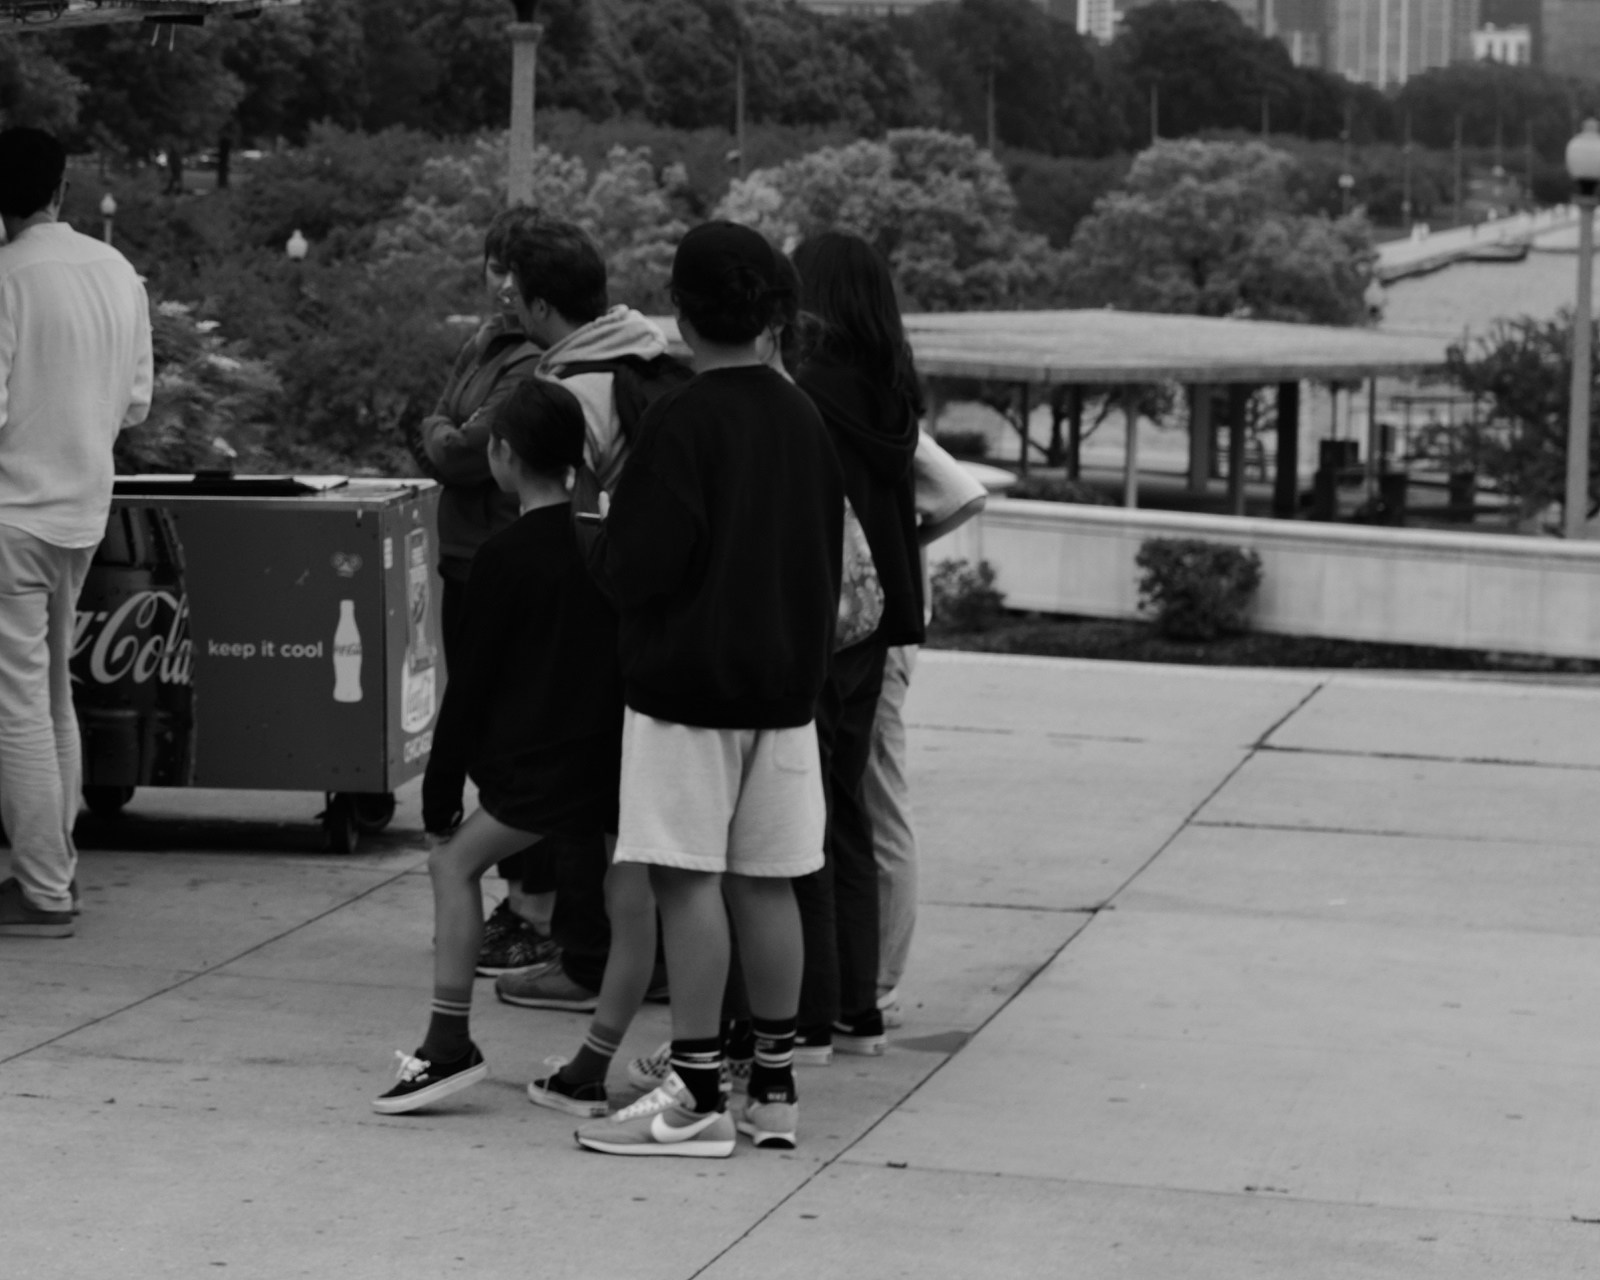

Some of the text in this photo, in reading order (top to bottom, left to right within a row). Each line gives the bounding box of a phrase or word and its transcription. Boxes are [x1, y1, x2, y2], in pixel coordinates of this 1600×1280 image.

[208, 639, 255, 660] keep
[261, 639, 275, 658] it
[280, 641, 323, 659] cool
